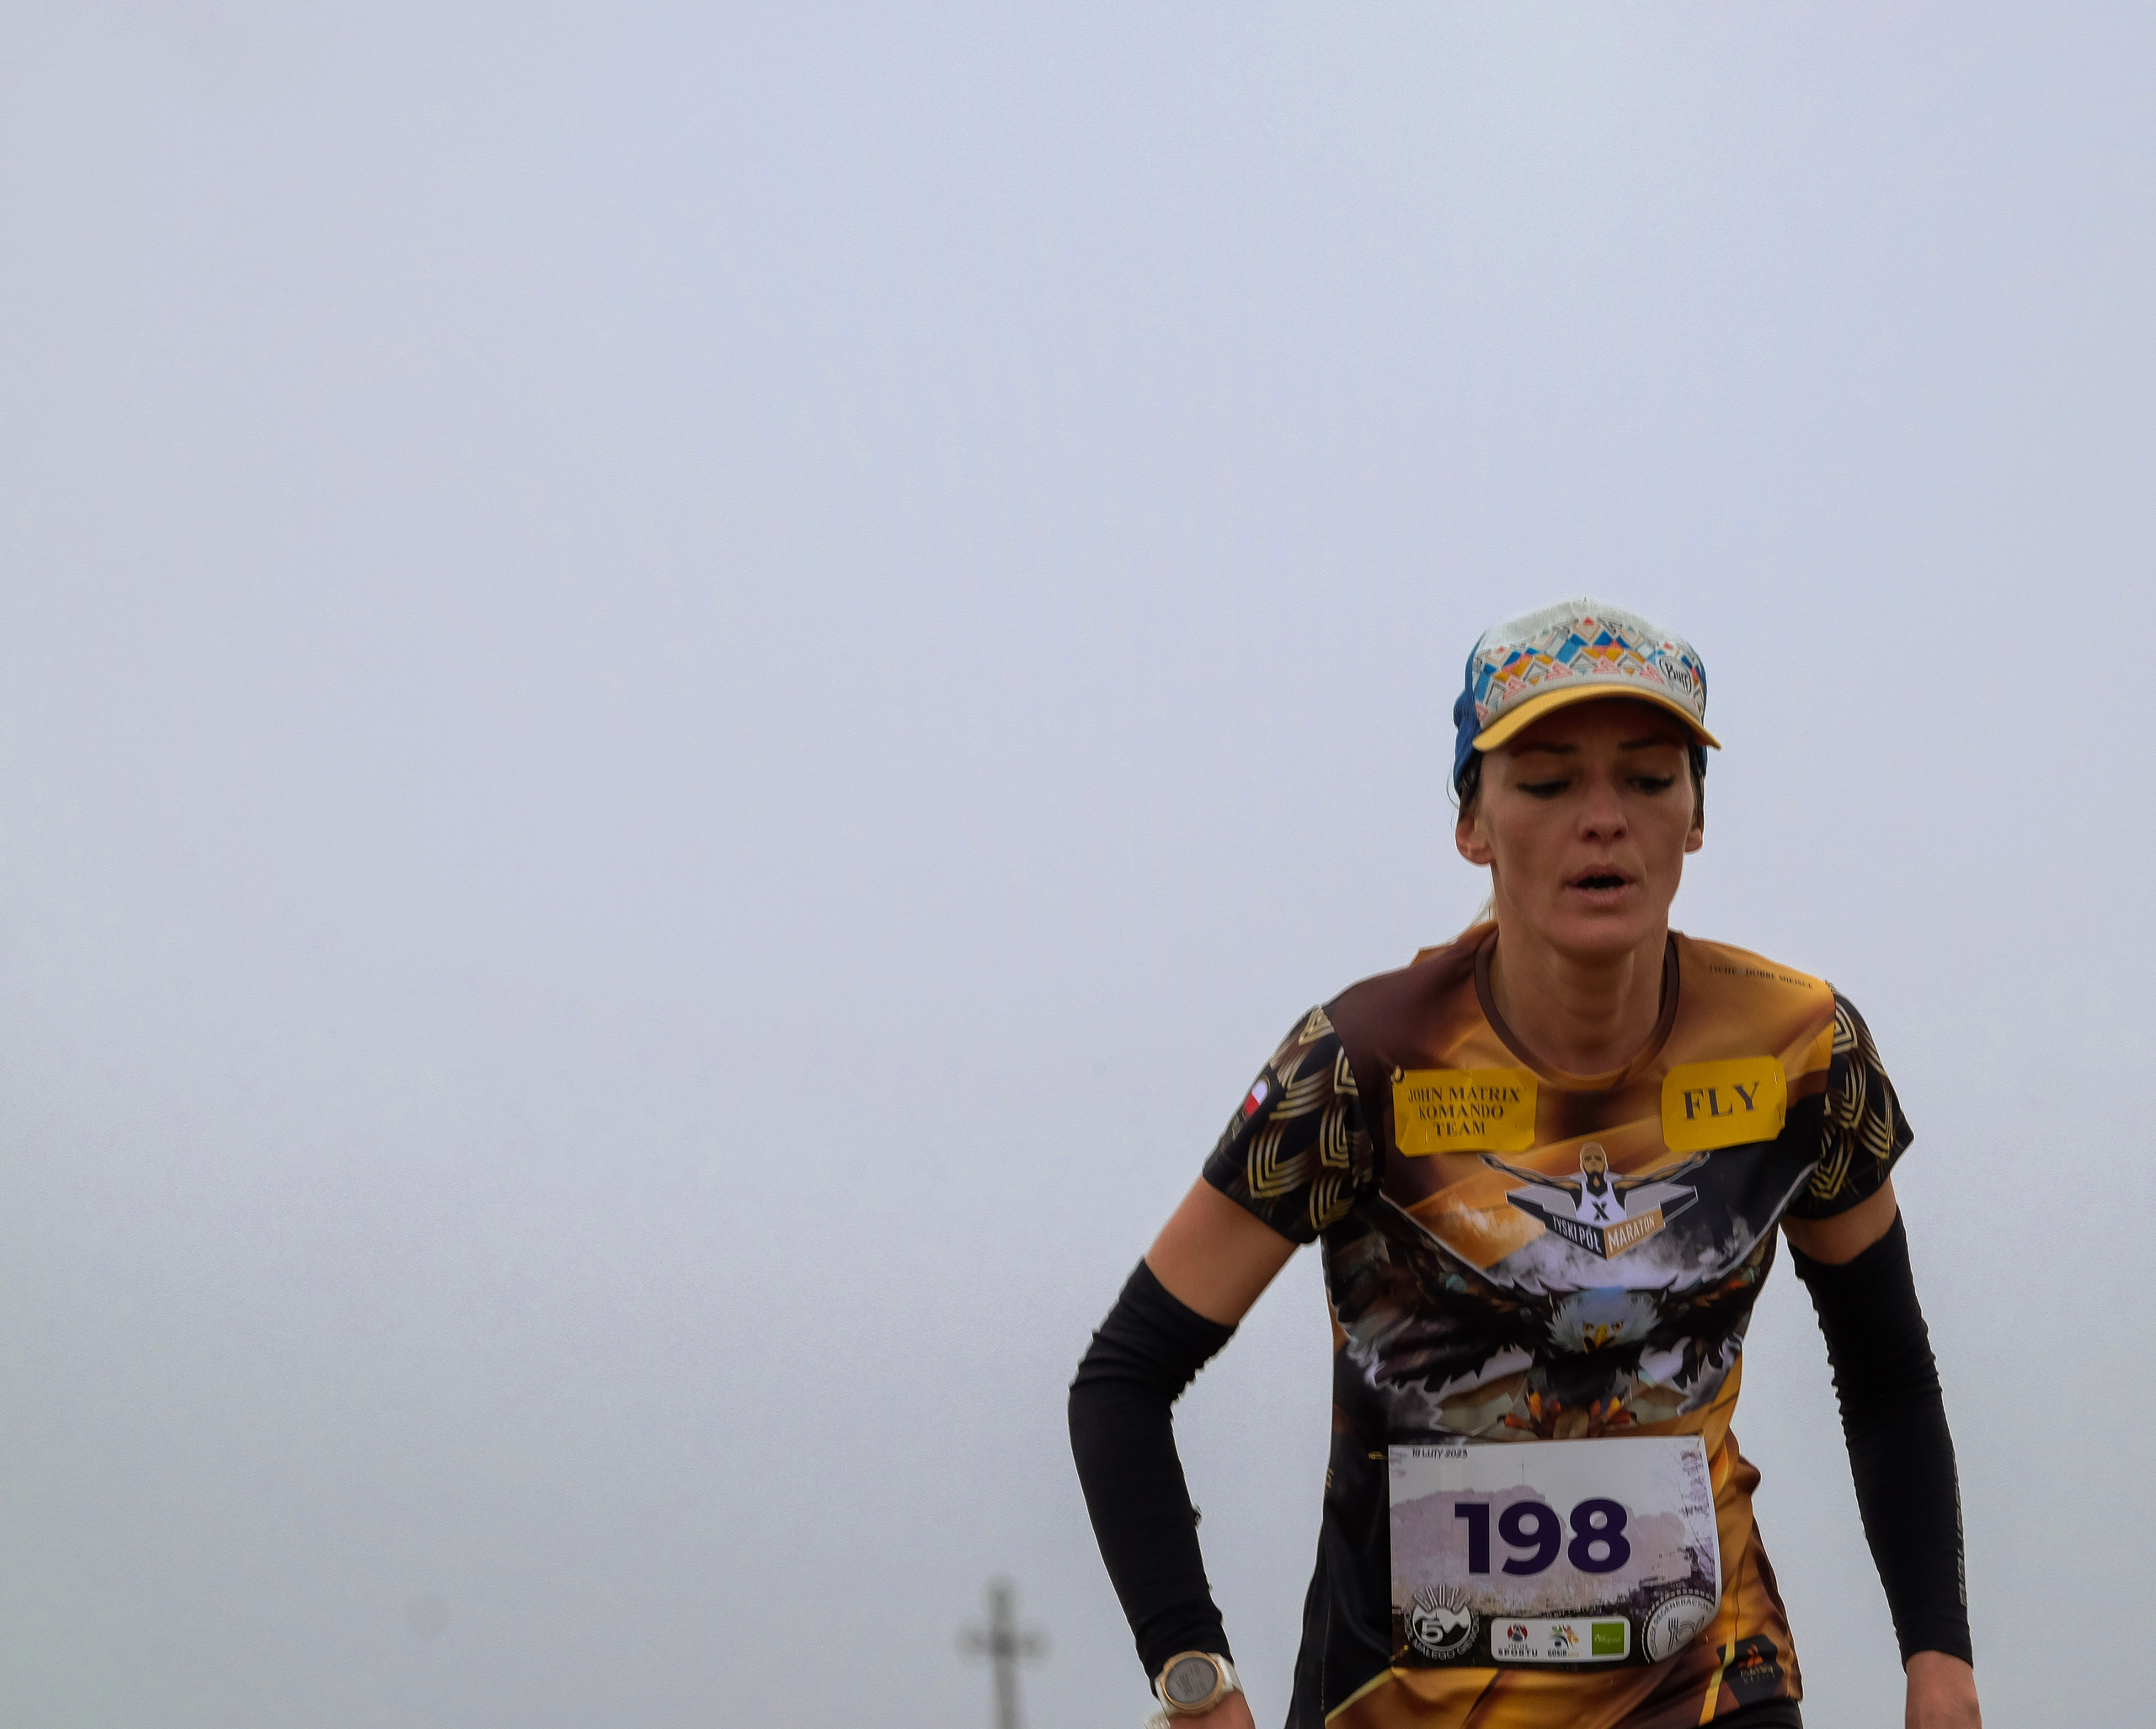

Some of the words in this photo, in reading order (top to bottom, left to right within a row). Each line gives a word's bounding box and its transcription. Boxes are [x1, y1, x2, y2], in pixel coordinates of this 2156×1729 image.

[1409, 1085, 1443, 1102] JOHN
[1449, 1085, 1519, 1102] MATRIX
[1682, 1081, 1758, 1121] FLY
[1418, 1103, 1504, 1121] KOMANDO
[1433, 1120, 1486, 1137] TEAM
[1552, 1214, 1577, 1243] TYSKI
[1607, 1214, 1656, 1253] MARATON
[1444, 1448, 1468, 1459] 2023
[1454, 1498, 1631, 1576] 198
